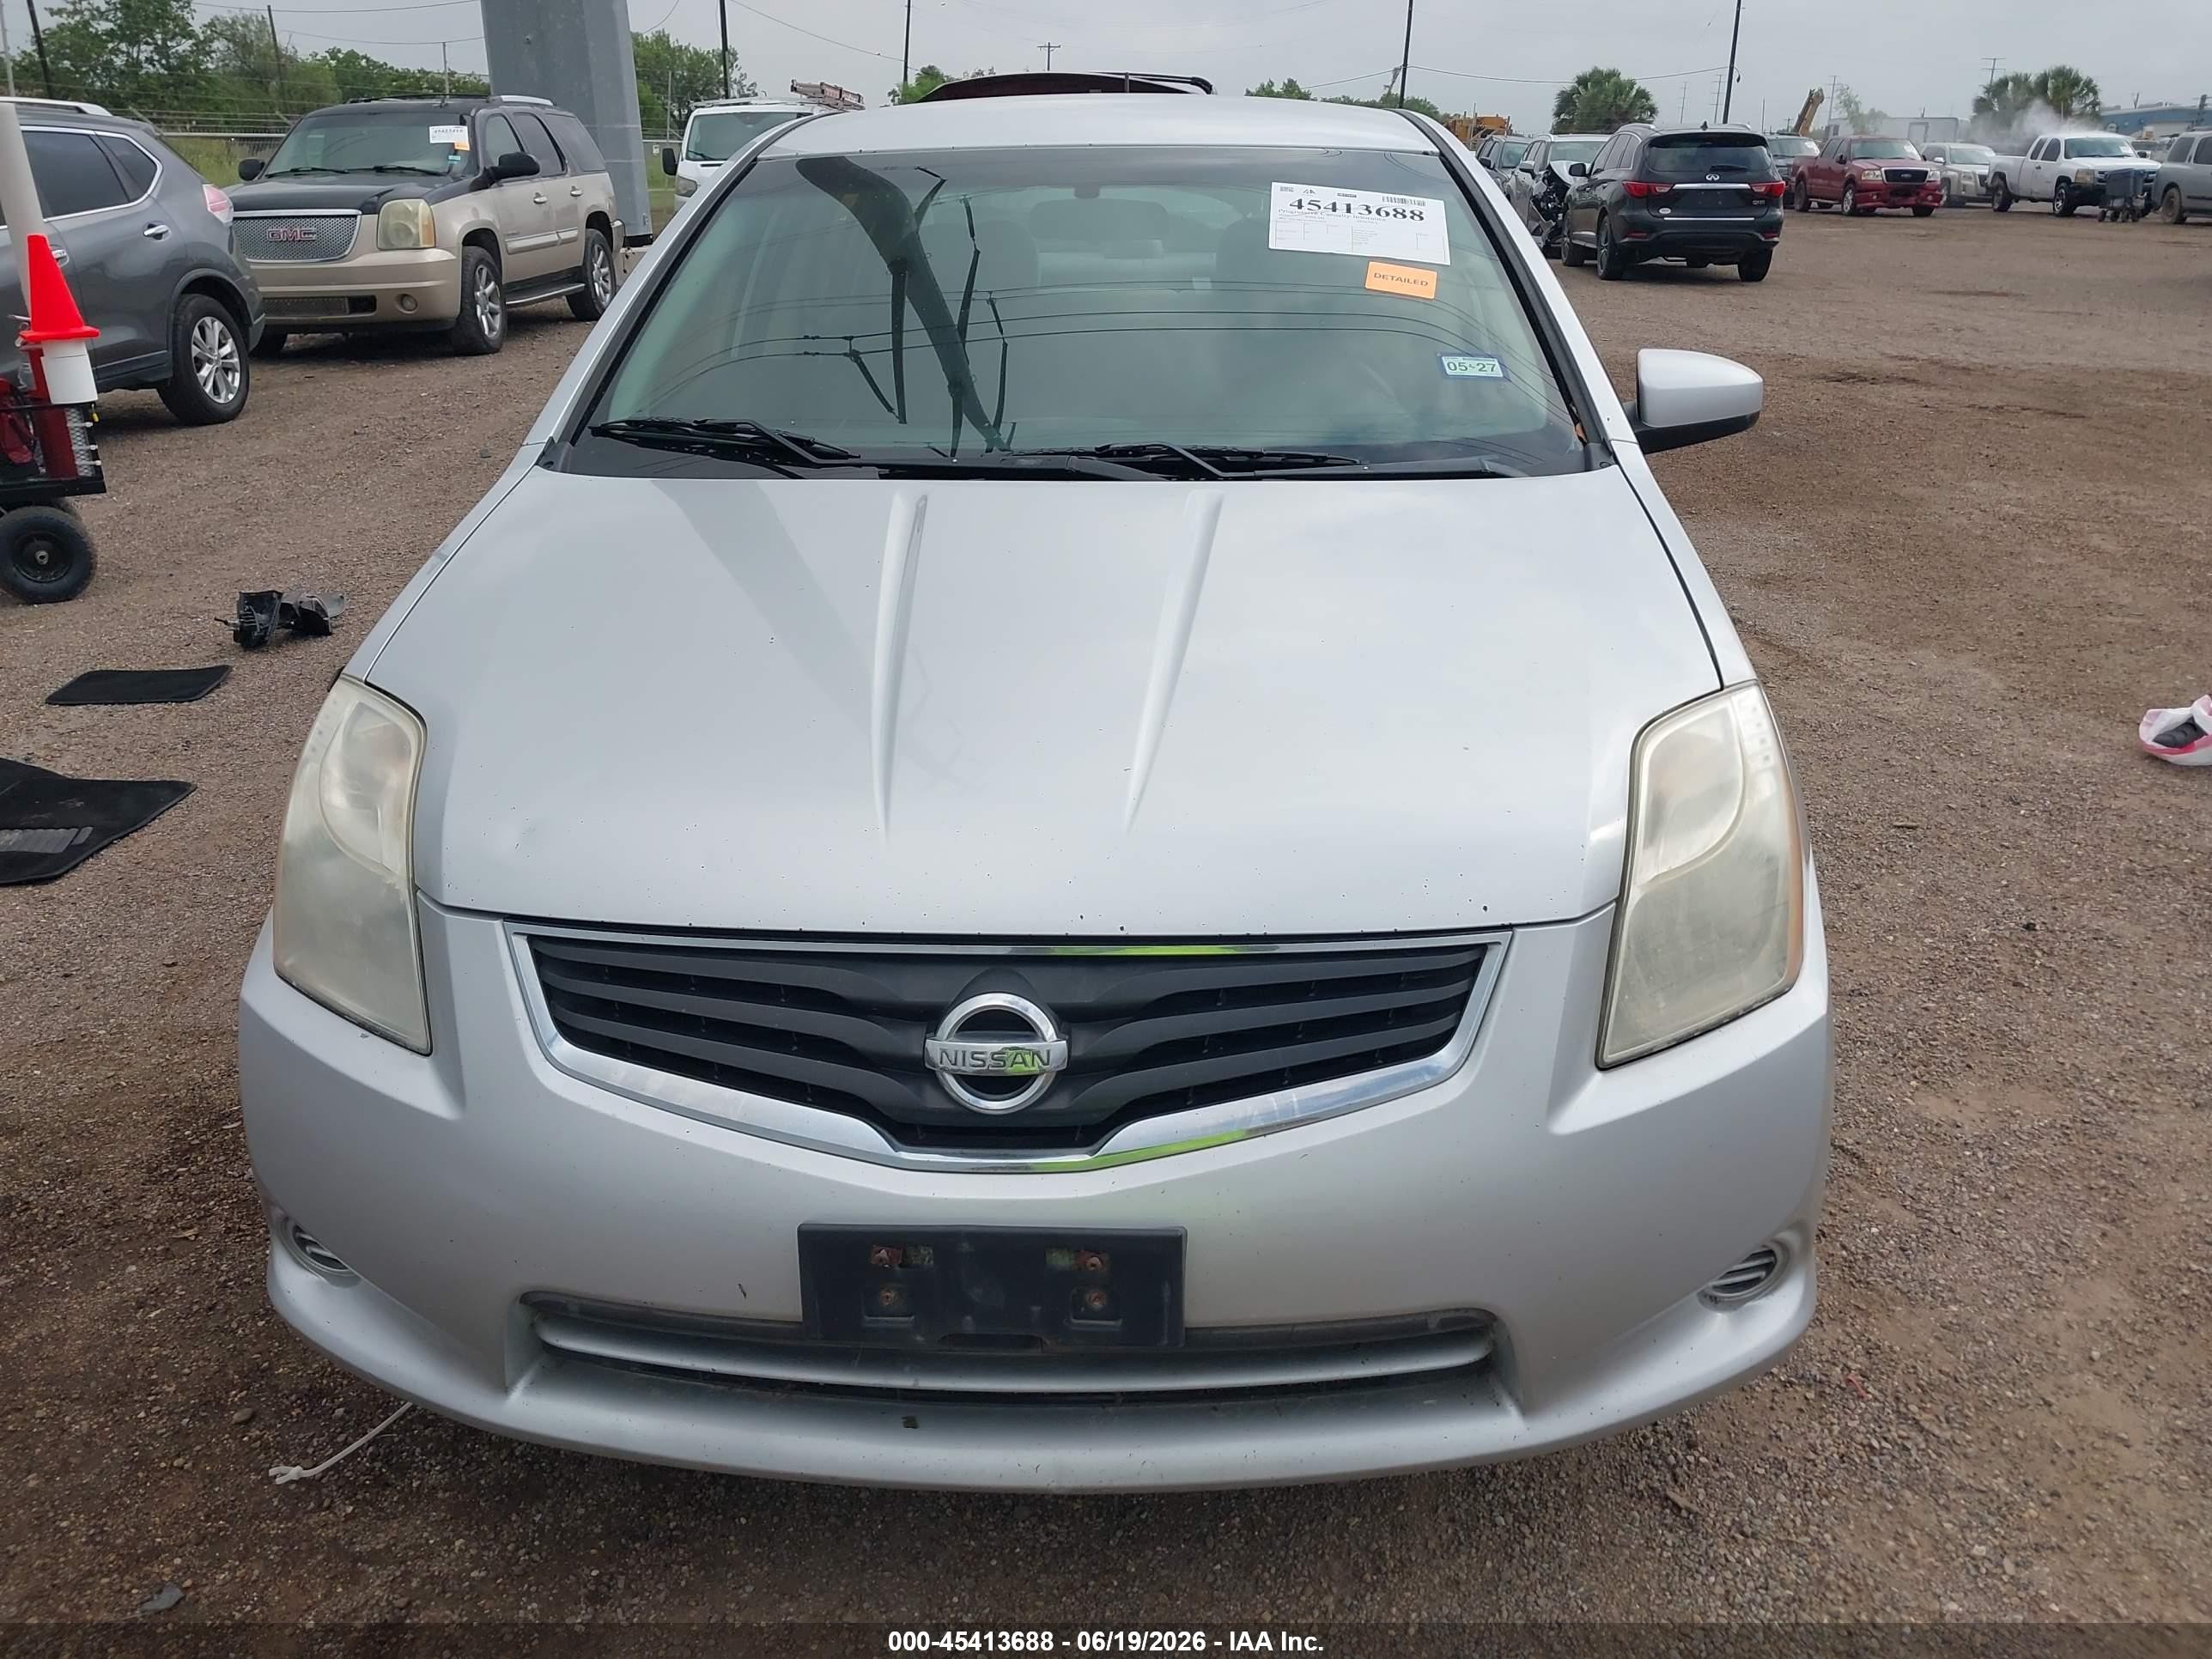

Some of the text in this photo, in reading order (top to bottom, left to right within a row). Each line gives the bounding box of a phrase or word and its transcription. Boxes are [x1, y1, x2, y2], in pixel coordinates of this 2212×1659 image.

[1289, 198, 1425, 222] 45413688
[267, 228, 317, 241] GMC
[1374, 272, 1429, 287] DETAILED
[939, 1048, 1052, 1068] NISSAN
